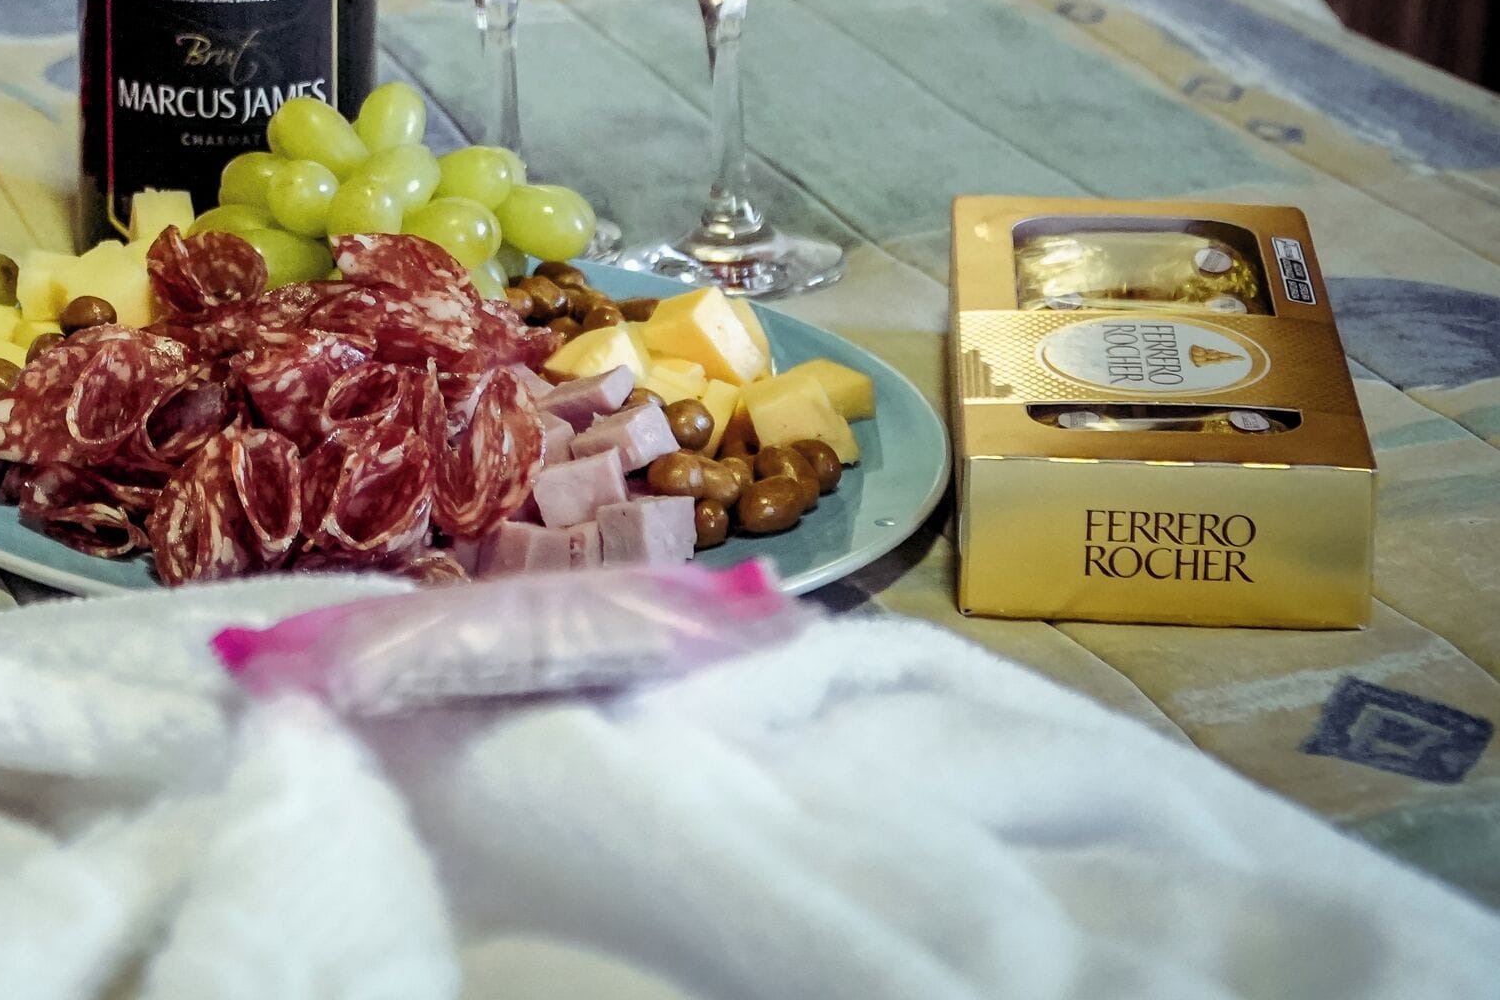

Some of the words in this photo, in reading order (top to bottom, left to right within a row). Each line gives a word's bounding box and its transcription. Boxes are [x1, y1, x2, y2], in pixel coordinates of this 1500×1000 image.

[176, 30, 259, 85] Brut
[117, 77, 237, 119] MARCUS
[1102, 324, 1144, 385] ROCHER
[1141, 324, 1184, 385] FERRERO
[1084, 509, 1257, 547] FERRERO
[1084, 545, 1255, 583] ROCHER
